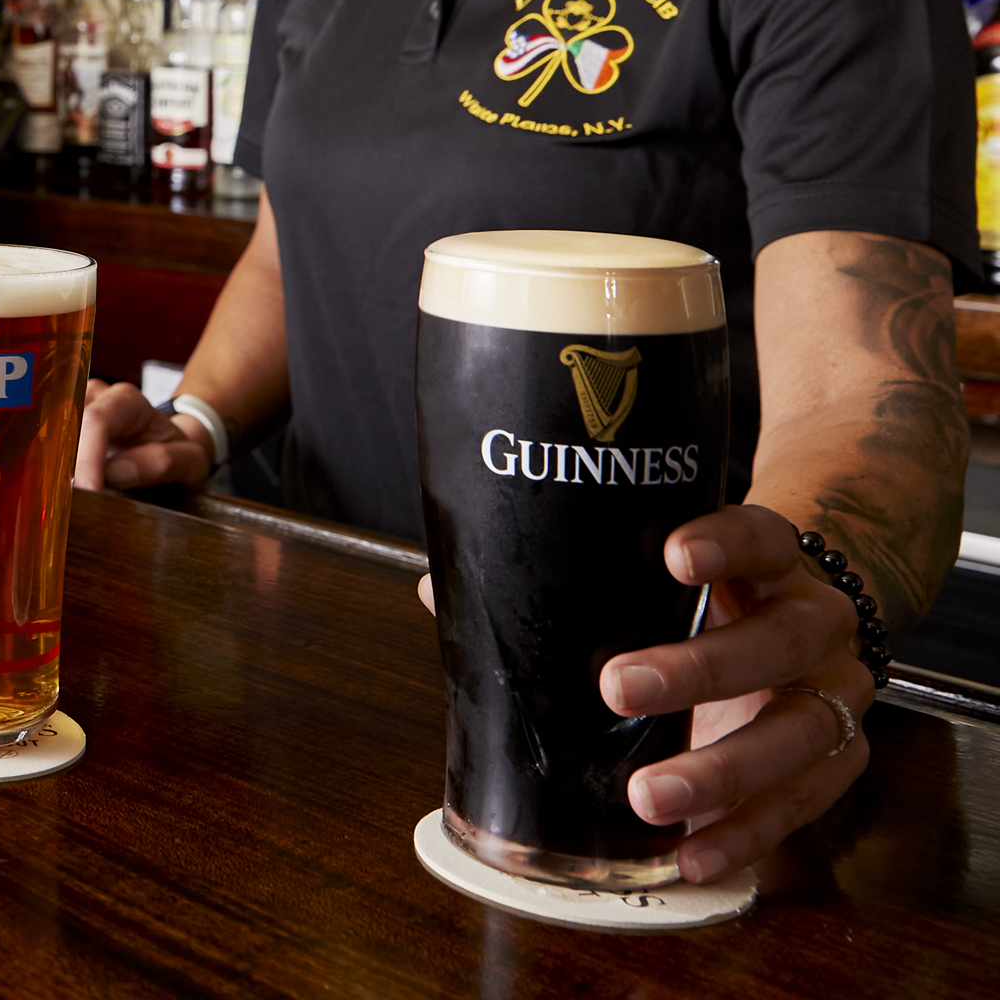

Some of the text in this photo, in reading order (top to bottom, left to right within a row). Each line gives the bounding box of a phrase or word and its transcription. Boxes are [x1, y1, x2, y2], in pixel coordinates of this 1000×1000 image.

[459, 90, 498, 123] White
[583, 117, 632, 136] N.Y.
[481, 429, 698, 485] GUINNESS
